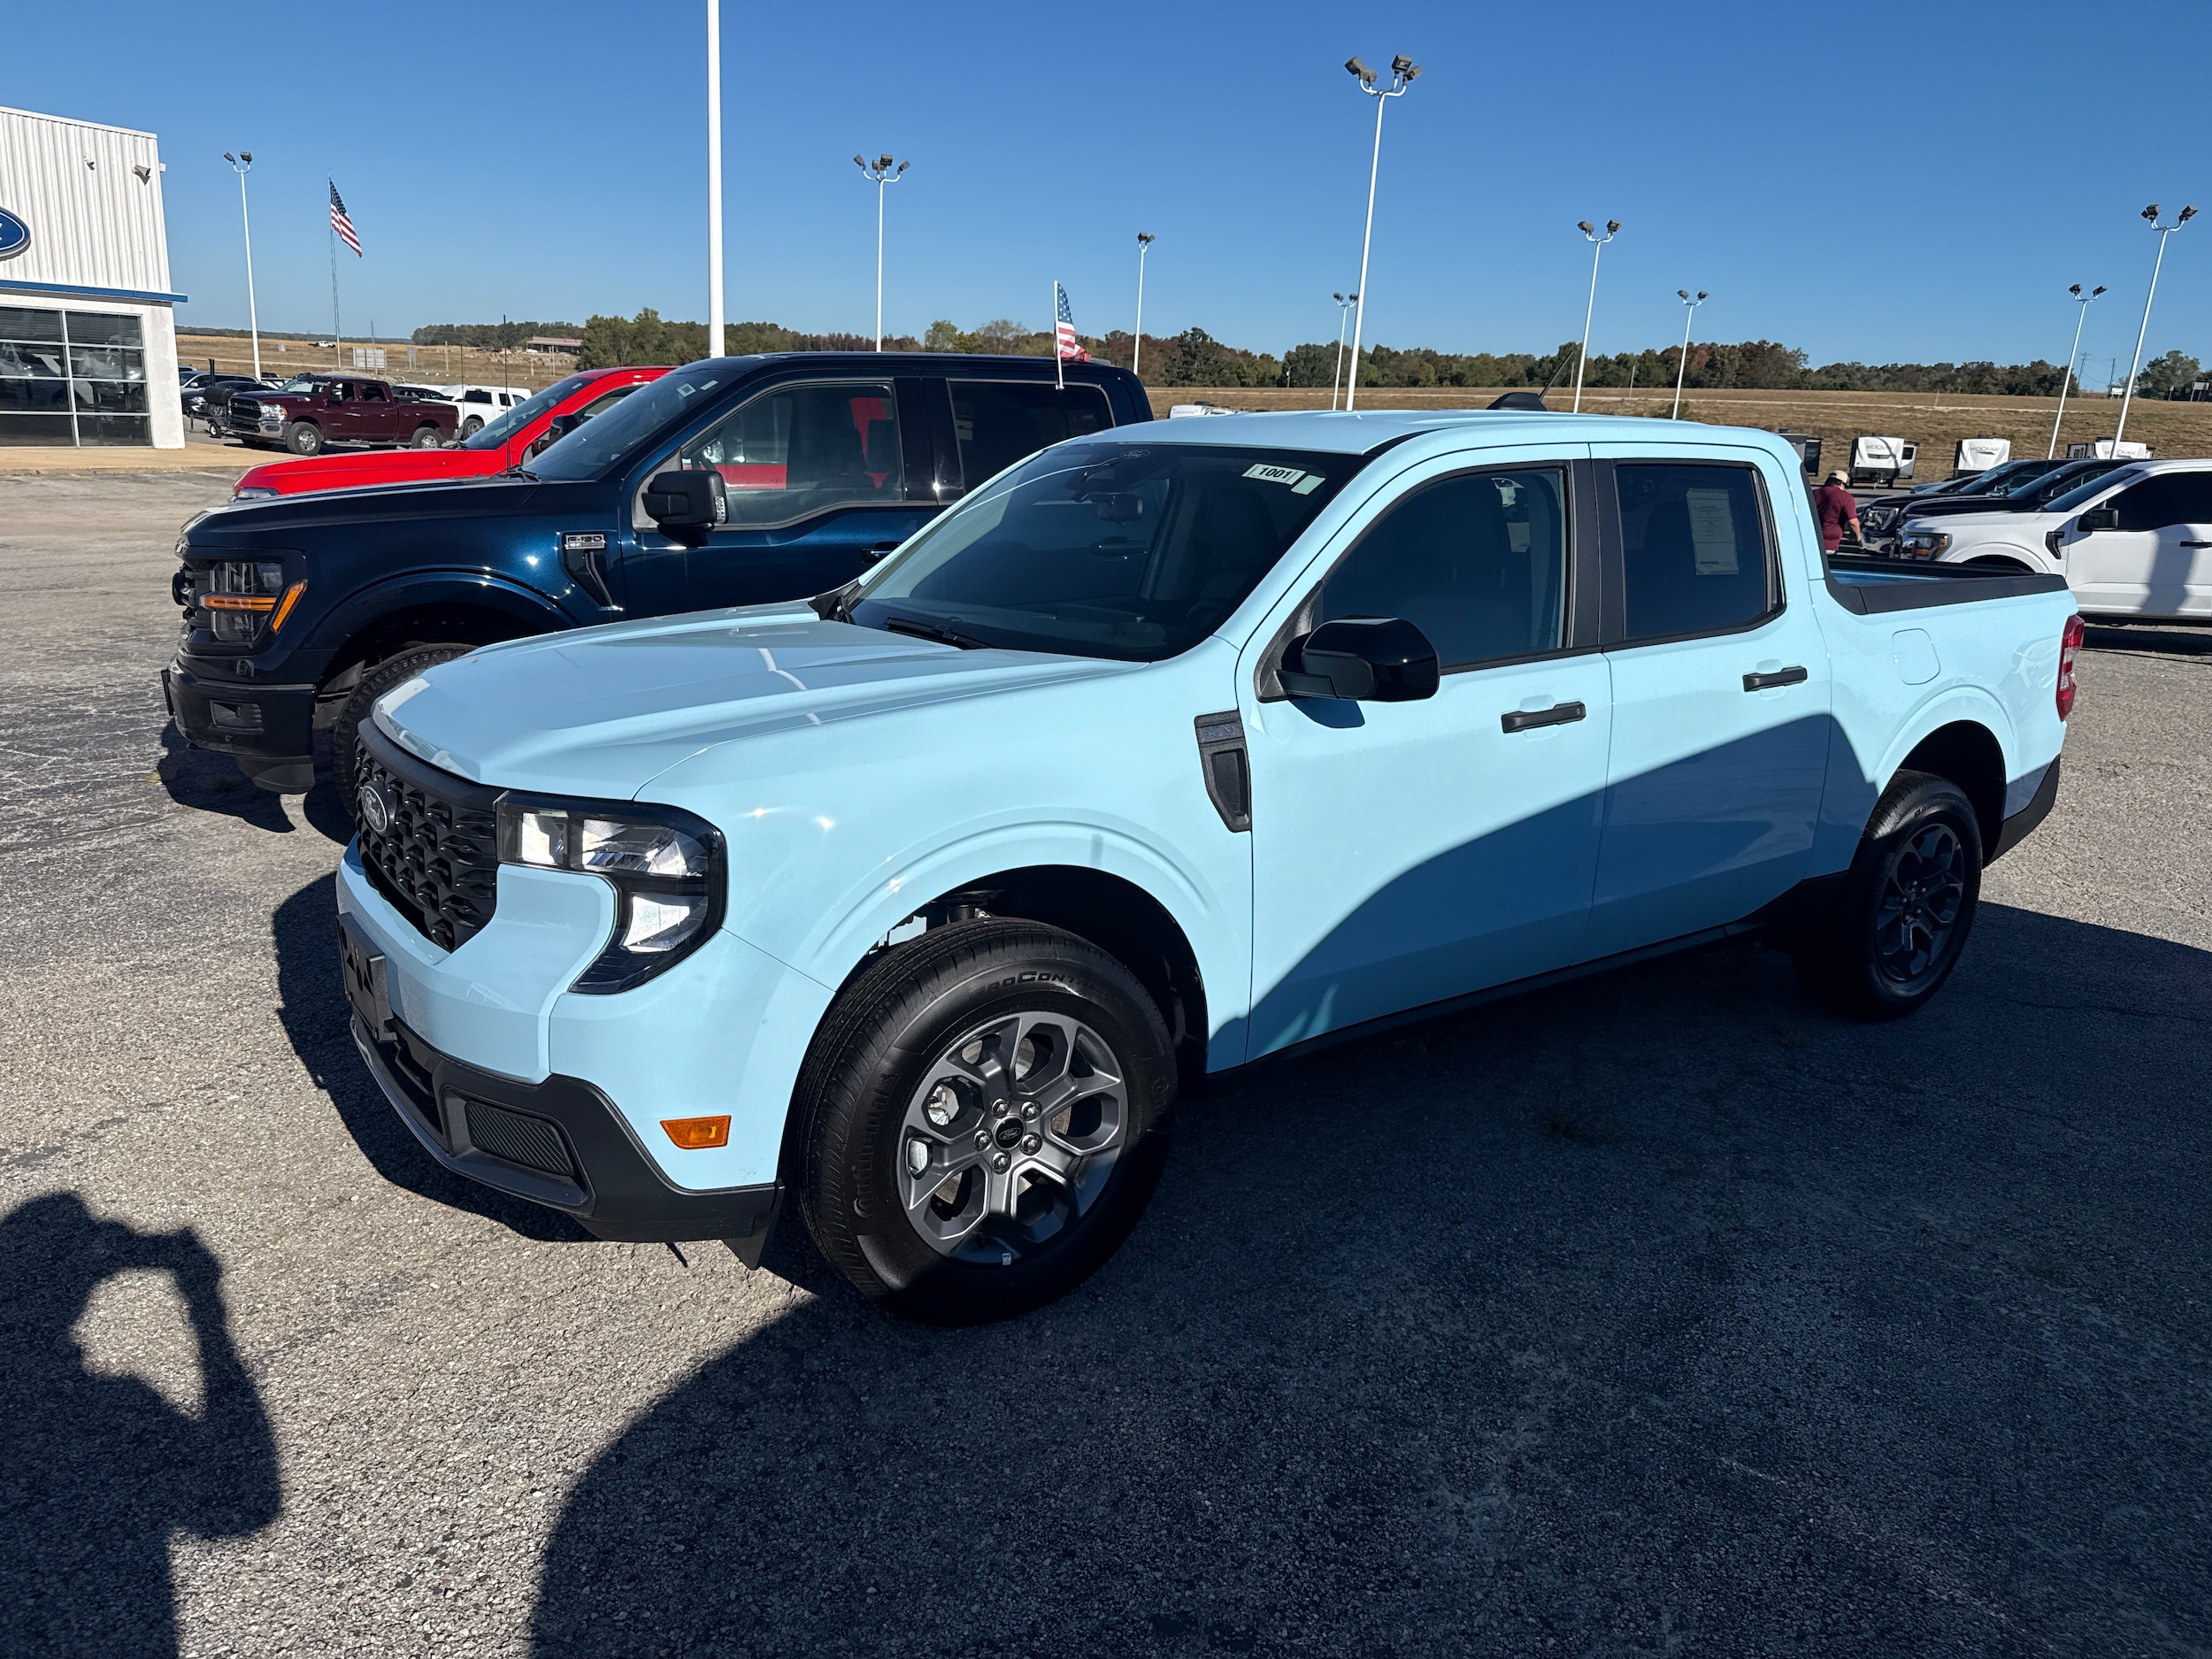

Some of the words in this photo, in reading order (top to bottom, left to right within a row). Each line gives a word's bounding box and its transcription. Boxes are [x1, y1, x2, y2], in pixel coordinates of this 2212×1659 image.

[1259, 467, 1293, 479] 1001
[1203, 724, 1240, 737] XLT
[365, 790, 380, 827] Ford
